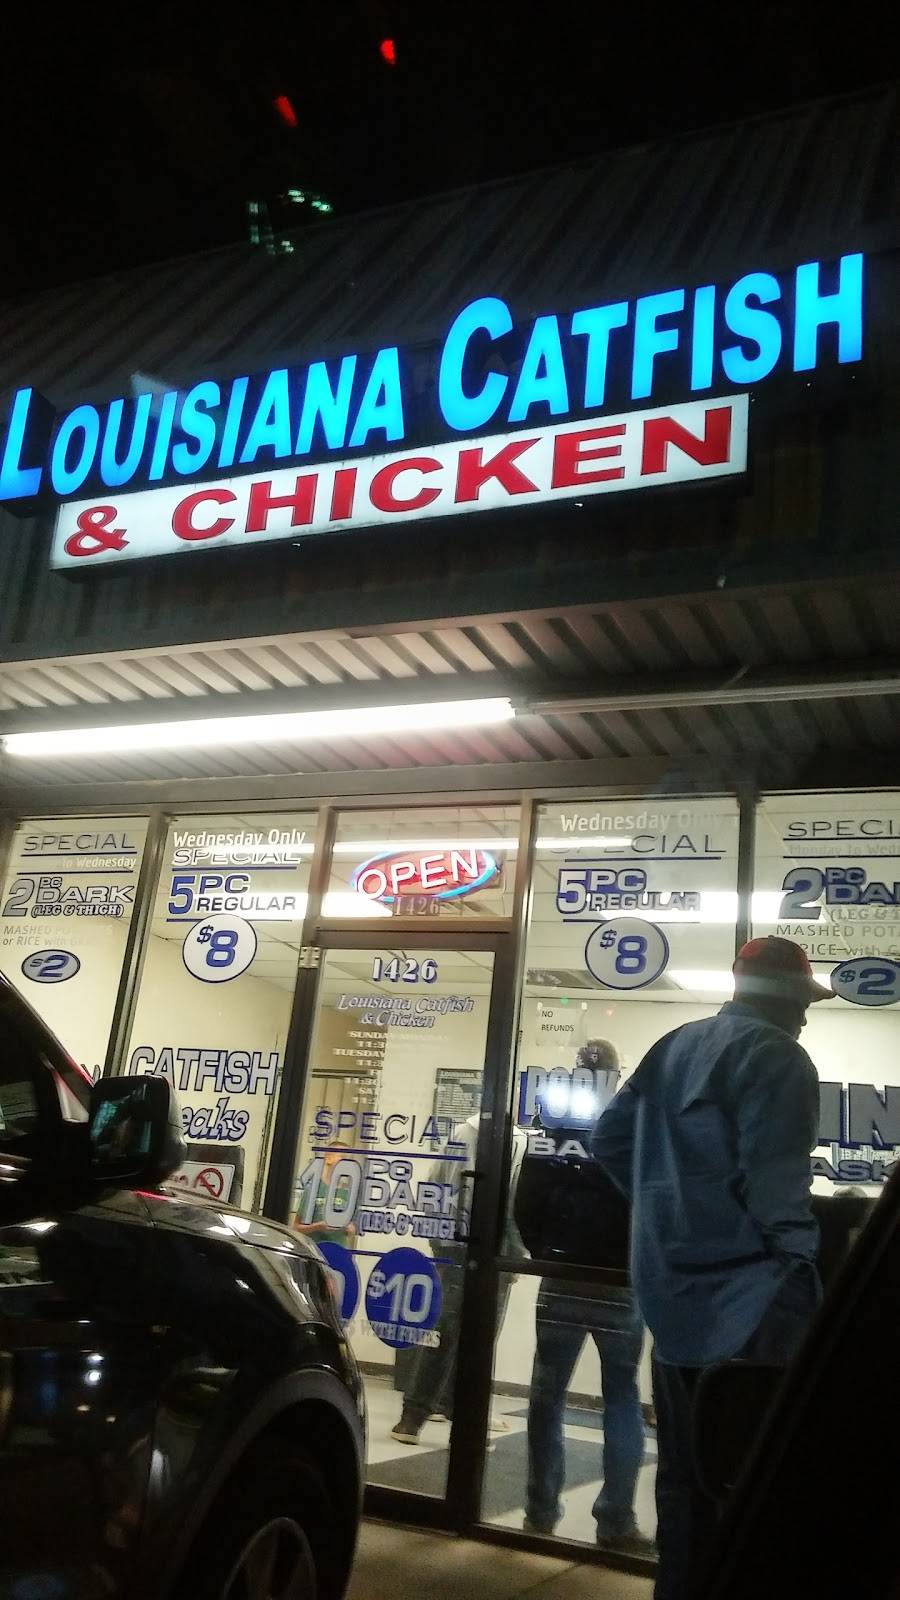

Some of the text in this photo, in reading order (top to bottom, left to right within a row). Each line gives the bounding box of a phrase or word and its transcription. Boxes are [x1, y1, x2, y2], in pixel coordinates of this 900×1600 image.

[0, 252, 865, 501] LOUISIANA CATFISH
[63, 405, 732, 557] & CHICKEN
[560, 811, 671, 833] Wednesday
[788, 819, 900, 837] SPECI
[23, 832, 135, 851] SPECIAL
[173, 828, 306, 848] Wednesday Only
[76, 856, 137, 868] Wednesday
[172, 848, 301, 866] SPECIAL
[357, 848, 480, 900] OPEN
[2, 876, 63, 918] 2 PC
[35, 885, 135, 905] DARK
[167, 874, 250, 915] 5 PC
[556, 867, 648, 915] 5 PC
[588, 890, 702, 912] REGULAR
[778, 866, 866, 919] 2 PC
[63, 904, 76, 917] &
[77, 904, 124, 918] THIGH)
[196, 896, 296, 912] REGULAR
[394, 896, 441, 916] 1426
[16, 935, 40, 946] RICE
[776, 924, 855, 937] MASHED
[196, 925, 239, 968] $8
[599, 929, 649, 975] $8
[29, 954, 70, 978] $2
[371, 956, 439, 983] 1426
[839, 967, 897, 996] $2
[337, 993, 476, 1015] Louisiana Catfish
[541, 1010, 554, 1018] NO
[359, 1009, 436, 1028] & Chicken
[129, 1046, 280, 1096] CATFISH
[309, 1109, 467, 1147] SPECIAL
[301, 1156, 364, 1229] 10
[360, 1177, 463, 1216] DARK
[367, 1270, 434, 1324] $10
